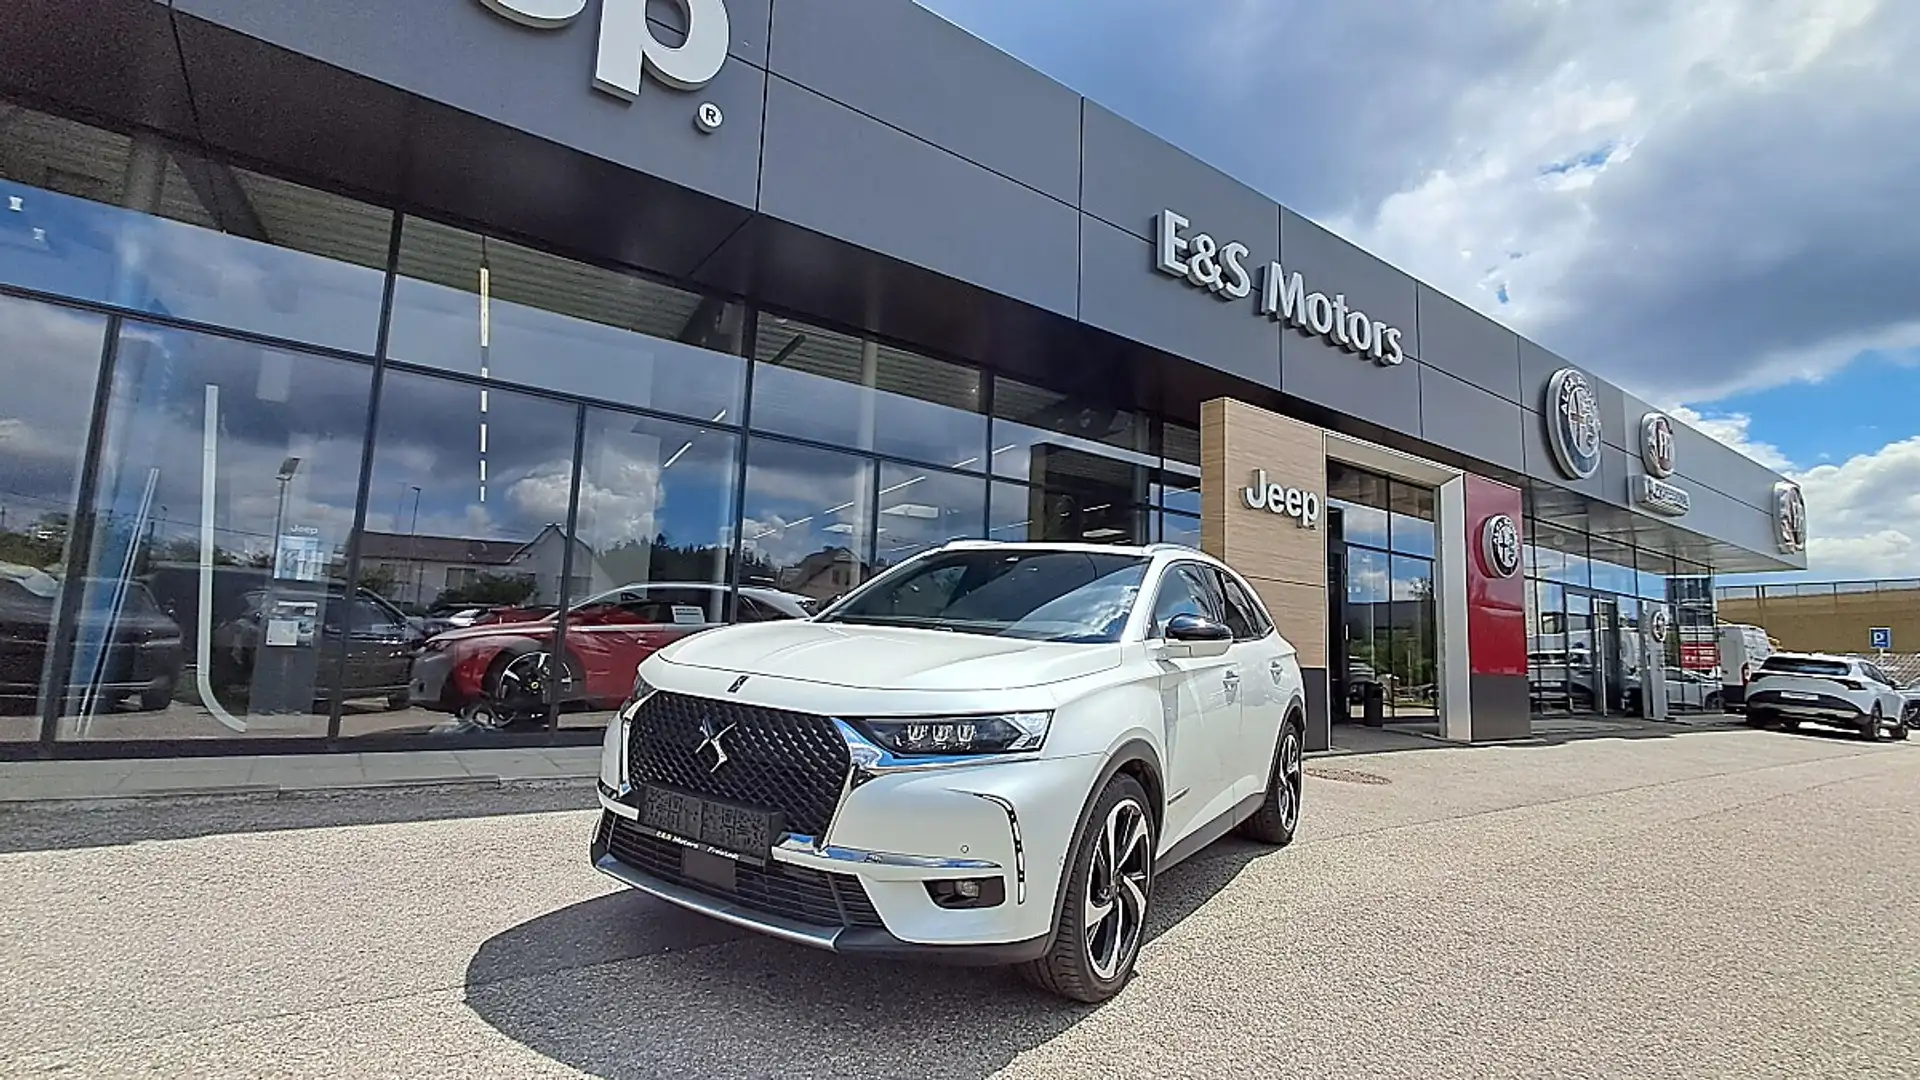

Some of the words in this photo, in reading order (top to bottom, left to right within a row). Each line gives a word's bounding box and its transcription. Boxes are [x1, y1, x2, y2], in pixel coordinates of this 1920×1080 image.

[1156, 209, 1251, 300] E&S
[1260, 261, 1403, 366] Motors
[1245, 468, 1320, 526] Jeep
[290, 524, 318, 535] Jeep
